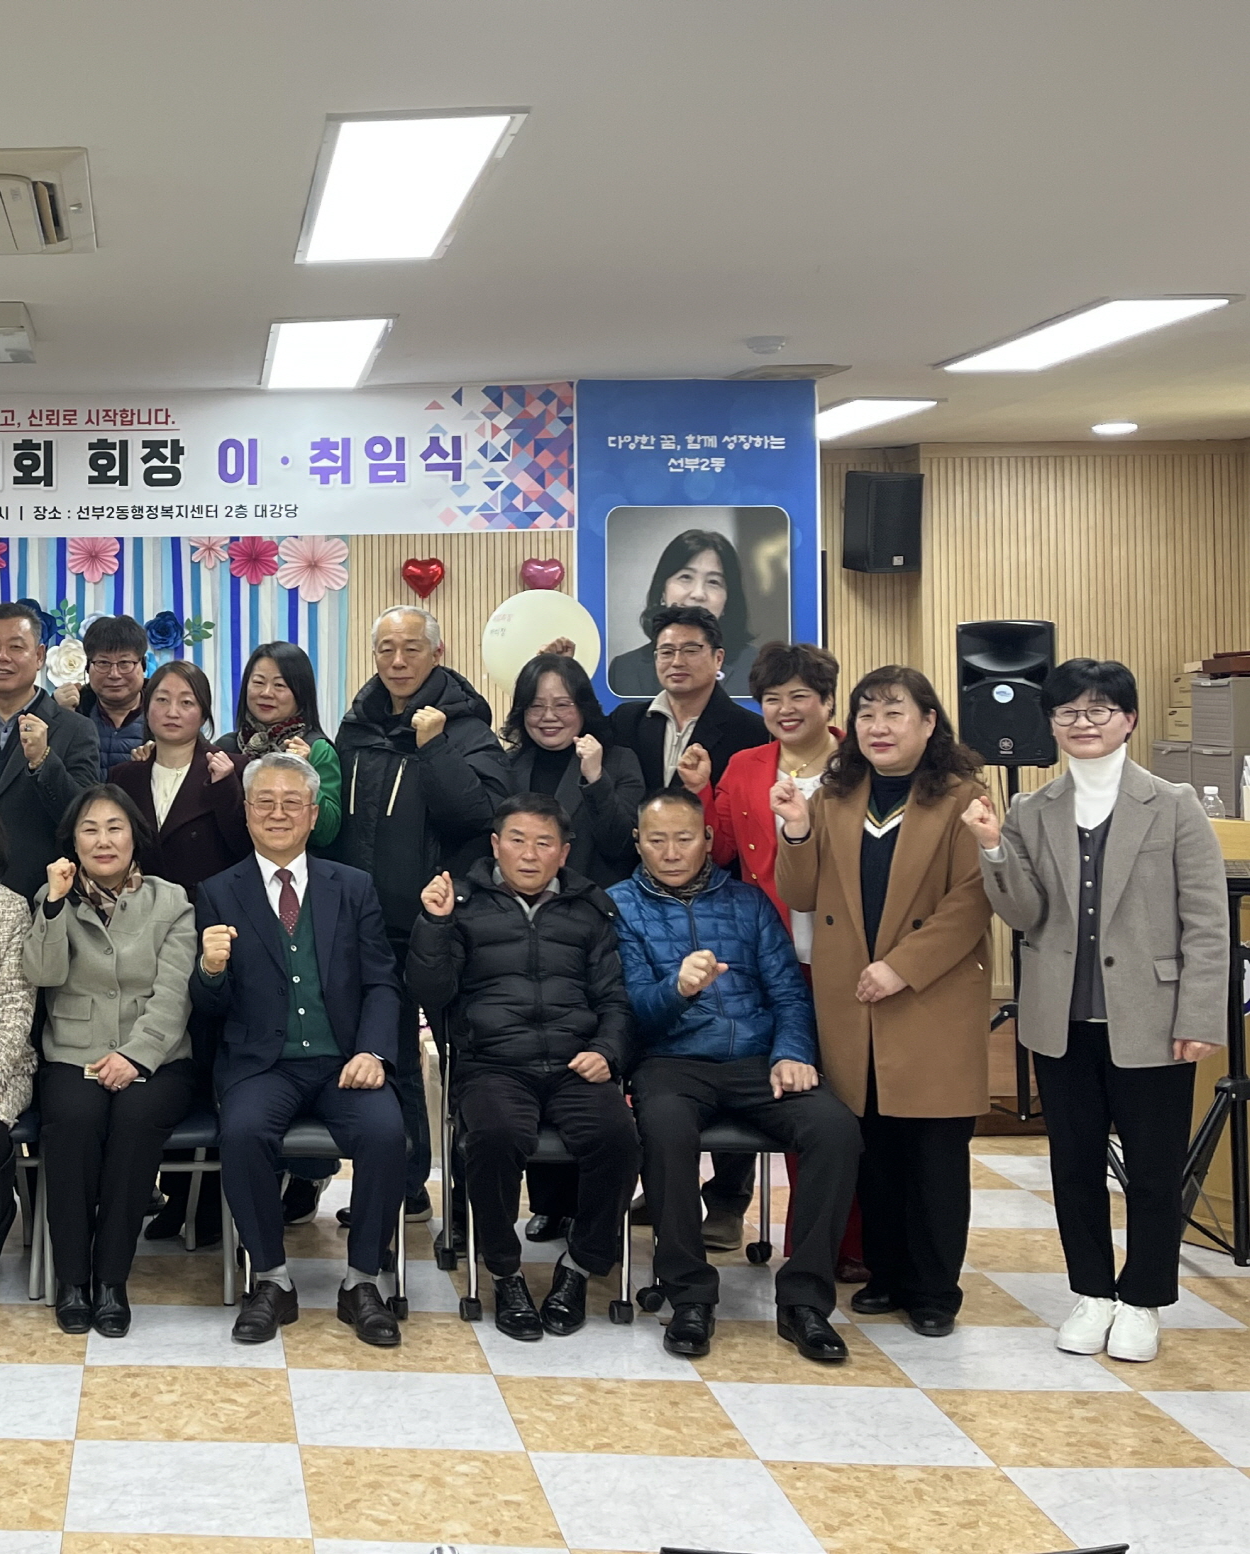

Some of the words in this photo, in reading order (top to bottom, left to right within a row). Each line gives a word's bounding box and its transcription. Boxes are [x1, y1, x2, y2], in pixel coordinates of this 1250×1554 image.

[28, 408, 78, 427] 신뢰로
[84, 407, 176, 426] 시작합니다.
[607, 435, 656, 450] 다양한
[660, 435, 681, 450] 꿈,
[685, 434, 718, 449] 함께
[722, 434, 786, 450] 성장하는
[87, 438, 185, 488] 회장
[668, 457, 726, 472] 선부2동
[33, 505, 62, 520] 장소
[76, 504, 219, 520] 선부2동행정복지센터
[224, 504, 249, 519] 2층
[254, 503, 299, 519] 대강당
